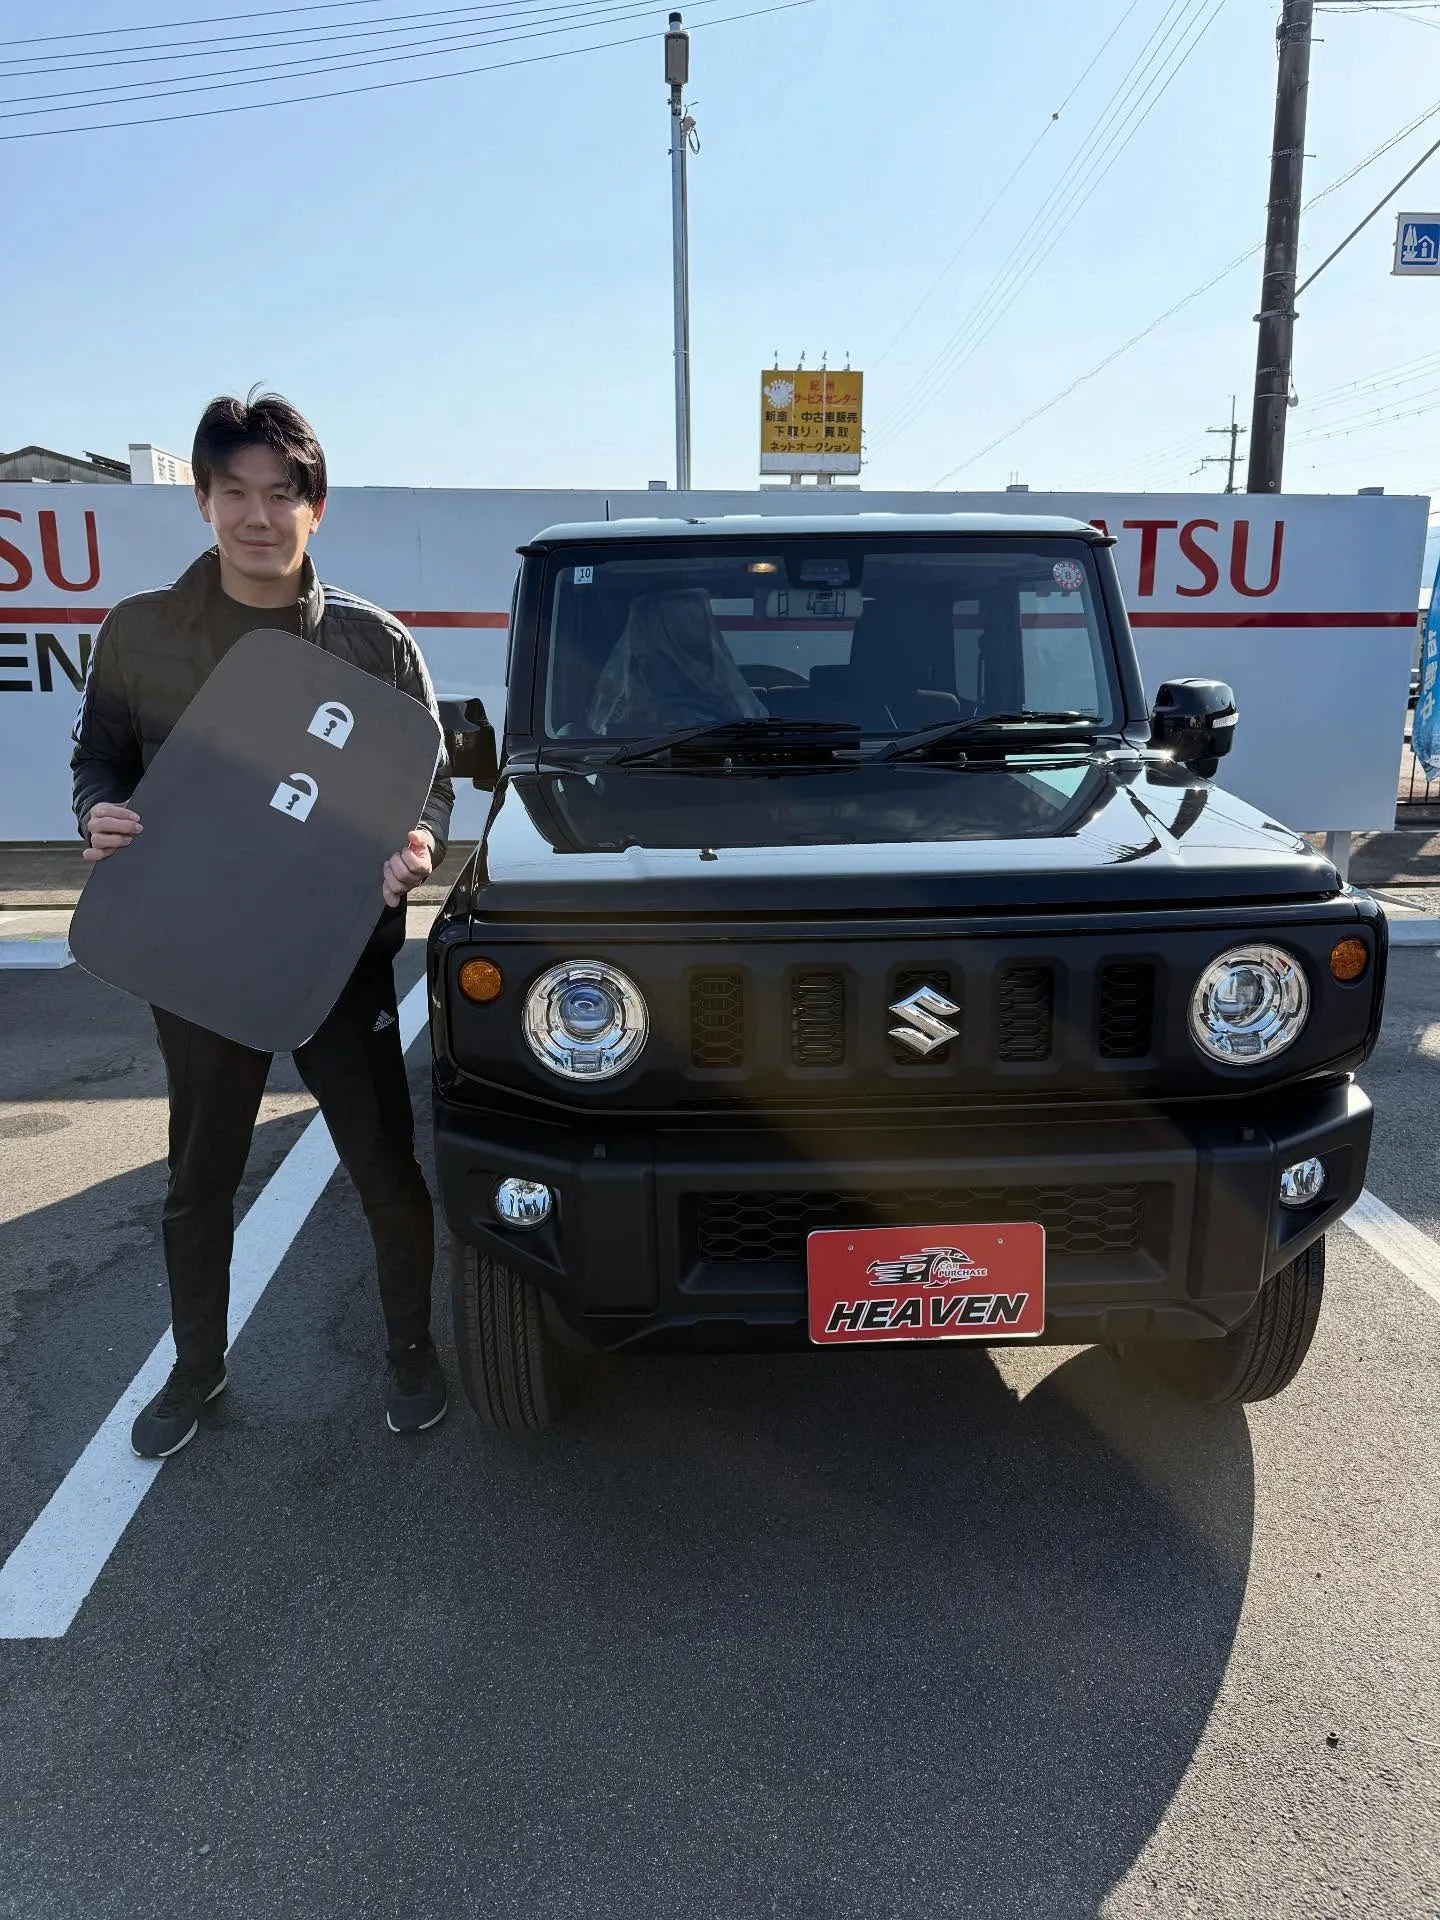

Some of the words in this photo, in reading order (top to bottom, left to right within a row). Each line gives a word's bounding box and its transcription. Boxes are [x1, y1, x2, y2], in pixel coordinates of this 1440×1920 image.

[770, 442, 851, 453] ネットオークション
[0, 508, 100, 592] SU
[1089, 519, 1285, 597] TSU
[580, 567, 591, 578] 10
[939, 1262, 960, 1270] CAR
[938, 1268, 987, 1278] PURCHASE
[825, 1293, 1029, 1333] HEAVEN
